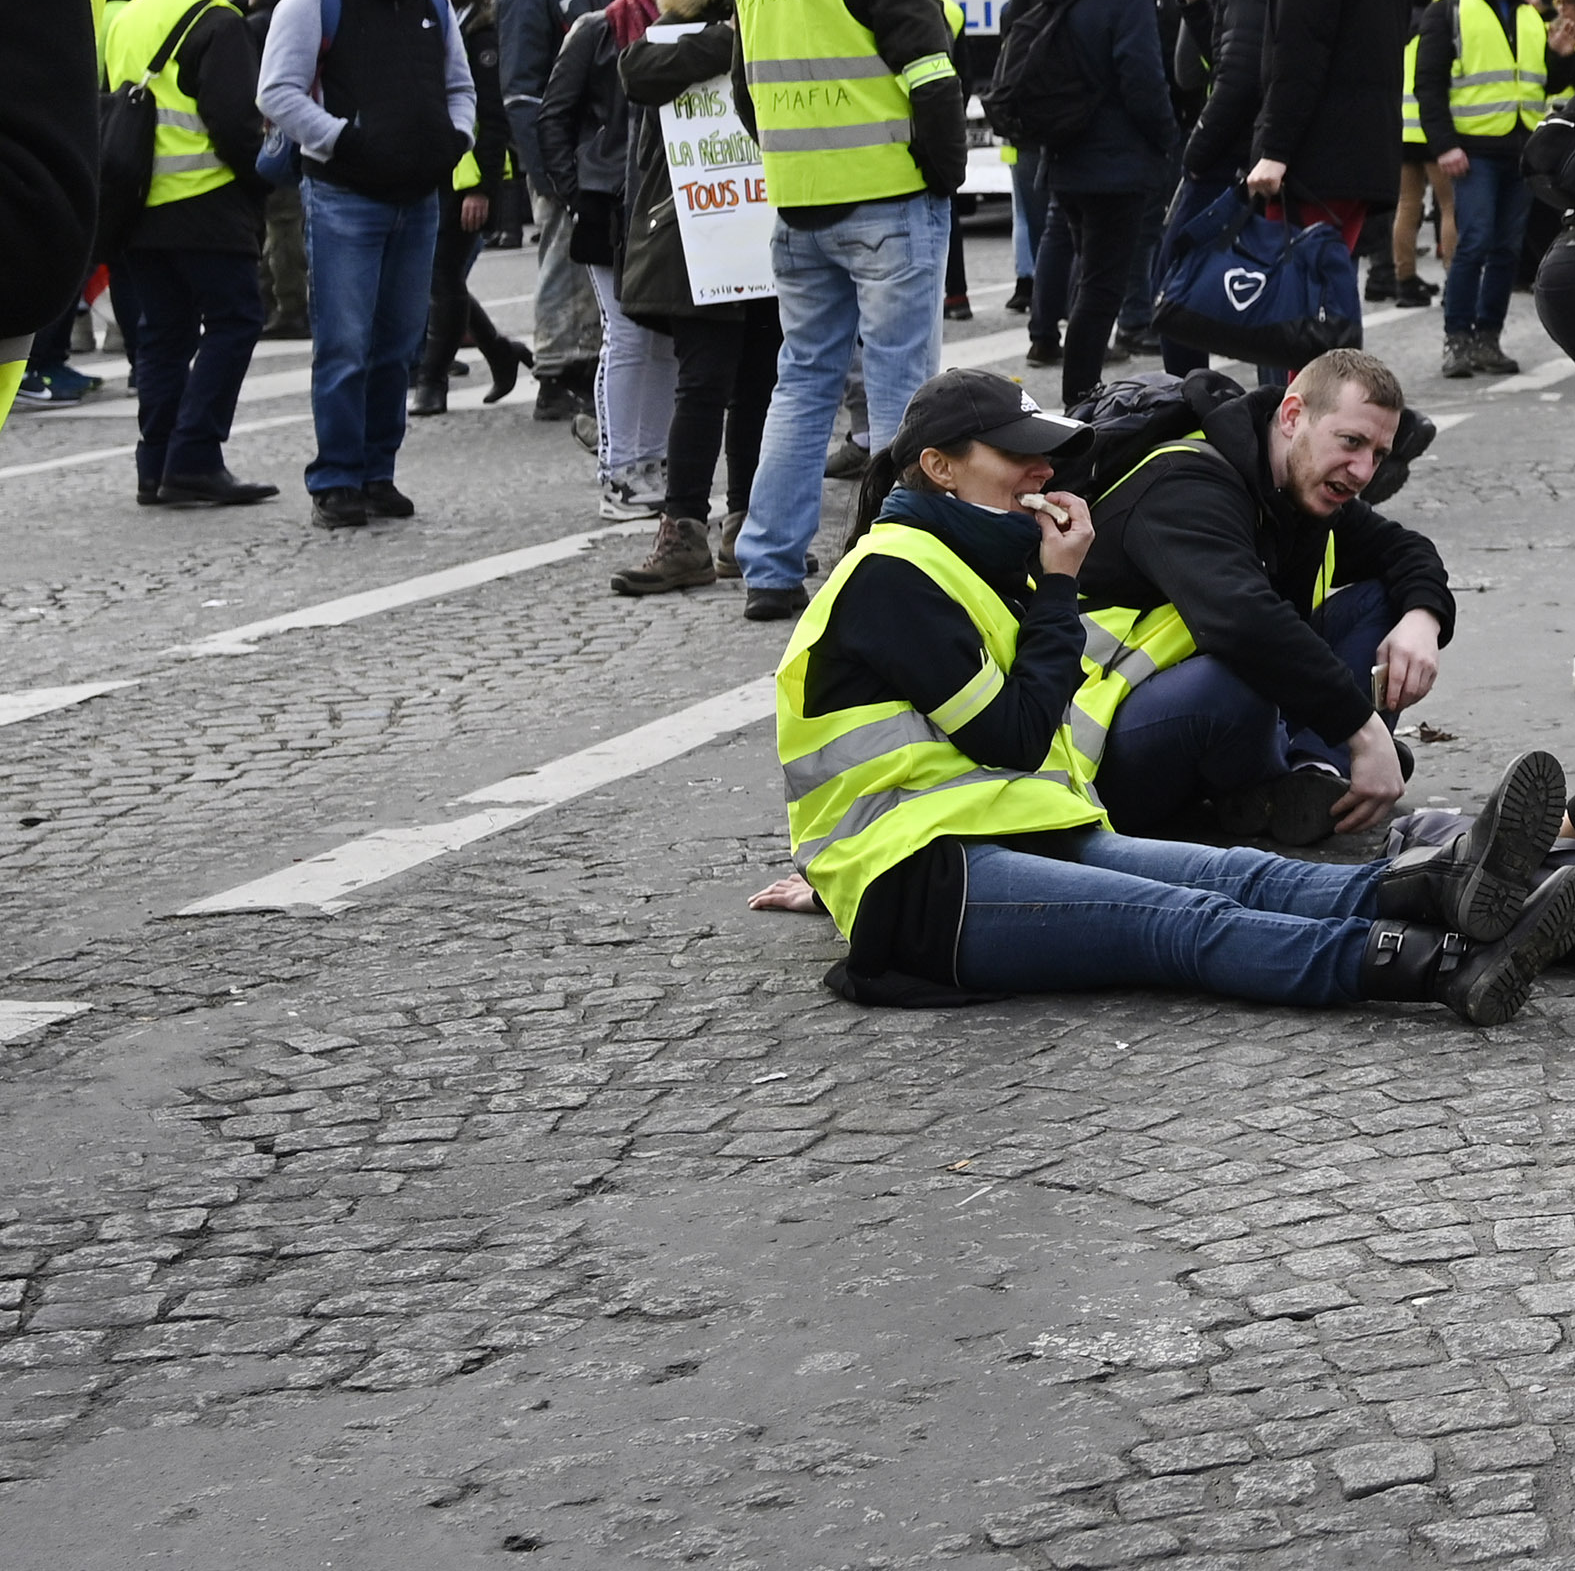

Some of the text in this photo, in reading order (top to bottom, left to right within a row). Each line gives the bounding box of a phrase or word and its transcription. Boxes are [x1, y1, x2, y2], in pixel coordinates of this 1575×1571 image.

[773, 86, 852, 113] MAFIA
[668, 140, 695, 168] LA
[678, 180, 740, 211] TOUS
